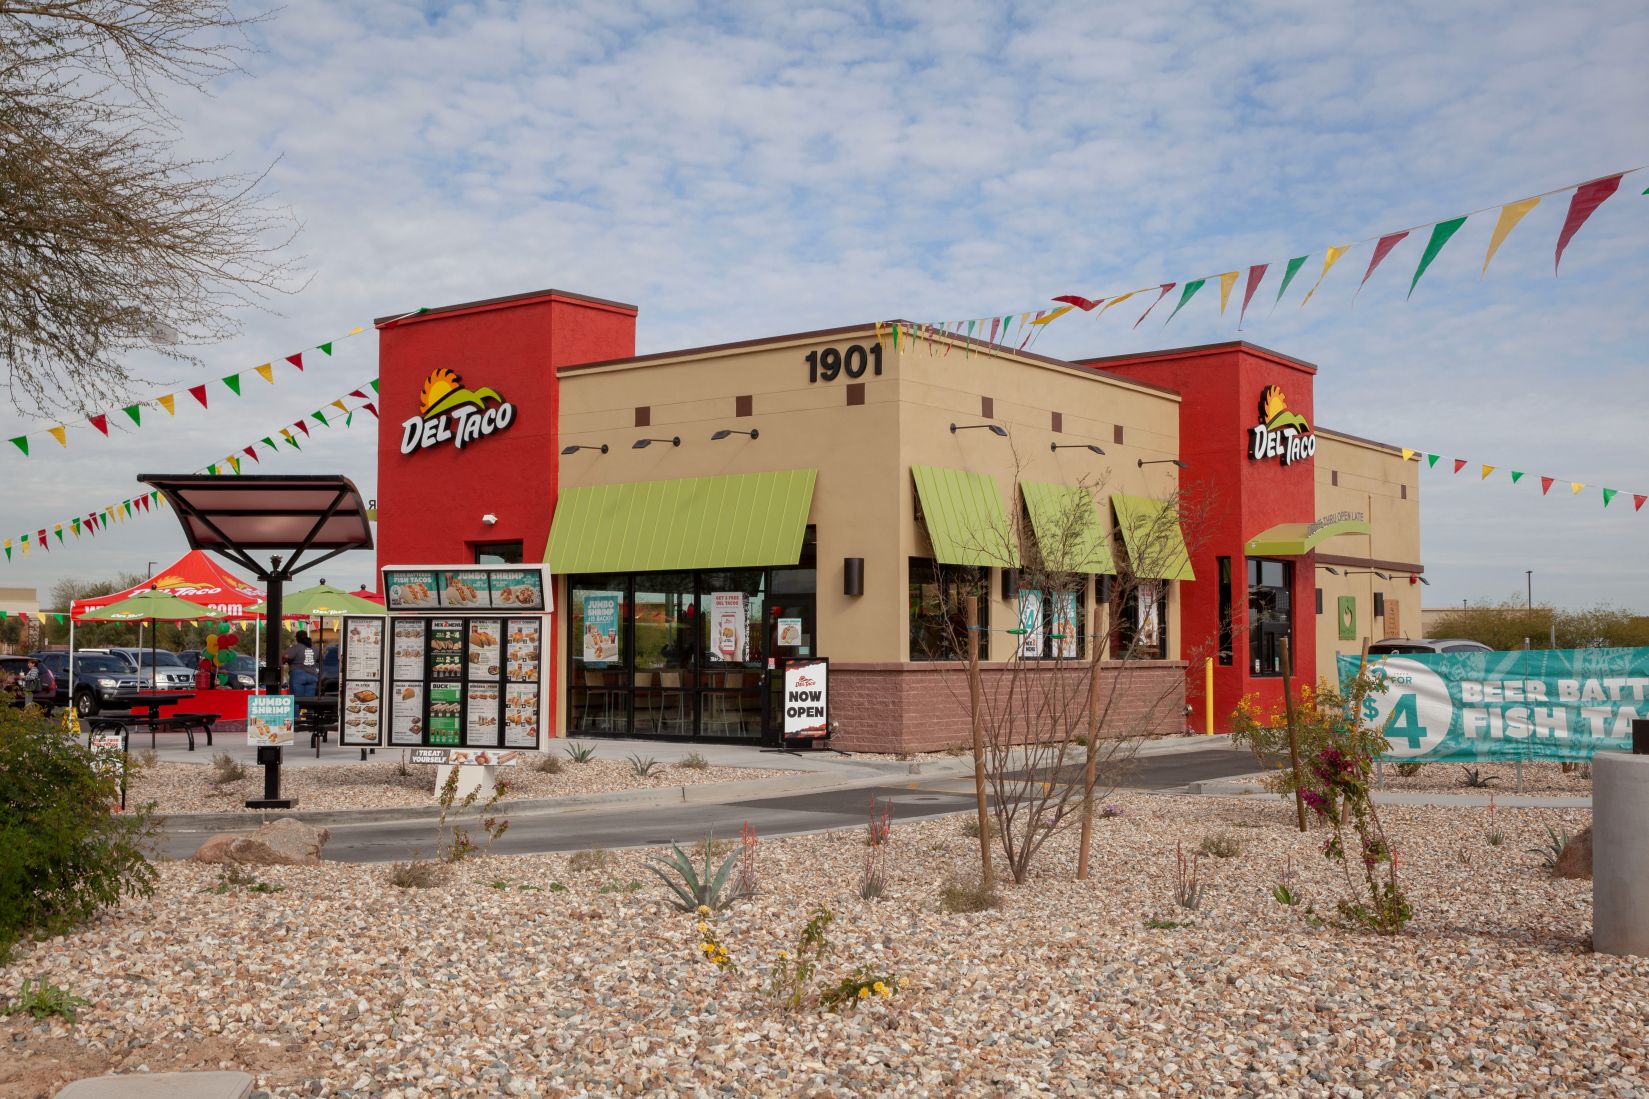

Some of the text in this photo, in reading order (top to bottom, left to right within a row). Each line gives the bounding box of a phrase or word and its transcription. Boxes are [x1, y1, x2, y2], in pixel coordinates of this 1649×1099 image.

[805, 342, 883, 383] 1901
[400, 404, 513, 454] DEL TACO
[1254, 424, 1316, 466] DEL TACO
[1322, 513, 1338, 525] THRU
[1337, 511, 1352, 521] OPEN
[1351, 511, 1364, 522] LATE
[458, 572, 487, 580] JUMBO
[491, 572, 524, 580] SHRIMP
[588, 600, 614, 609] JUMBO
[588, 608, 614, 616] SHRIMP
[1391, 676, 1413, 685] FOR
[1461, 677, 1649, 703] BEER BATT
[252, 698, 291, 706] JUMBO
[789, 691, 823, 703] NOW
[252, 706, 291, 714] SHRIMP
[786, 706, 825, 719] OPEN
[1462, 706, 1649, 739] FISH TA
